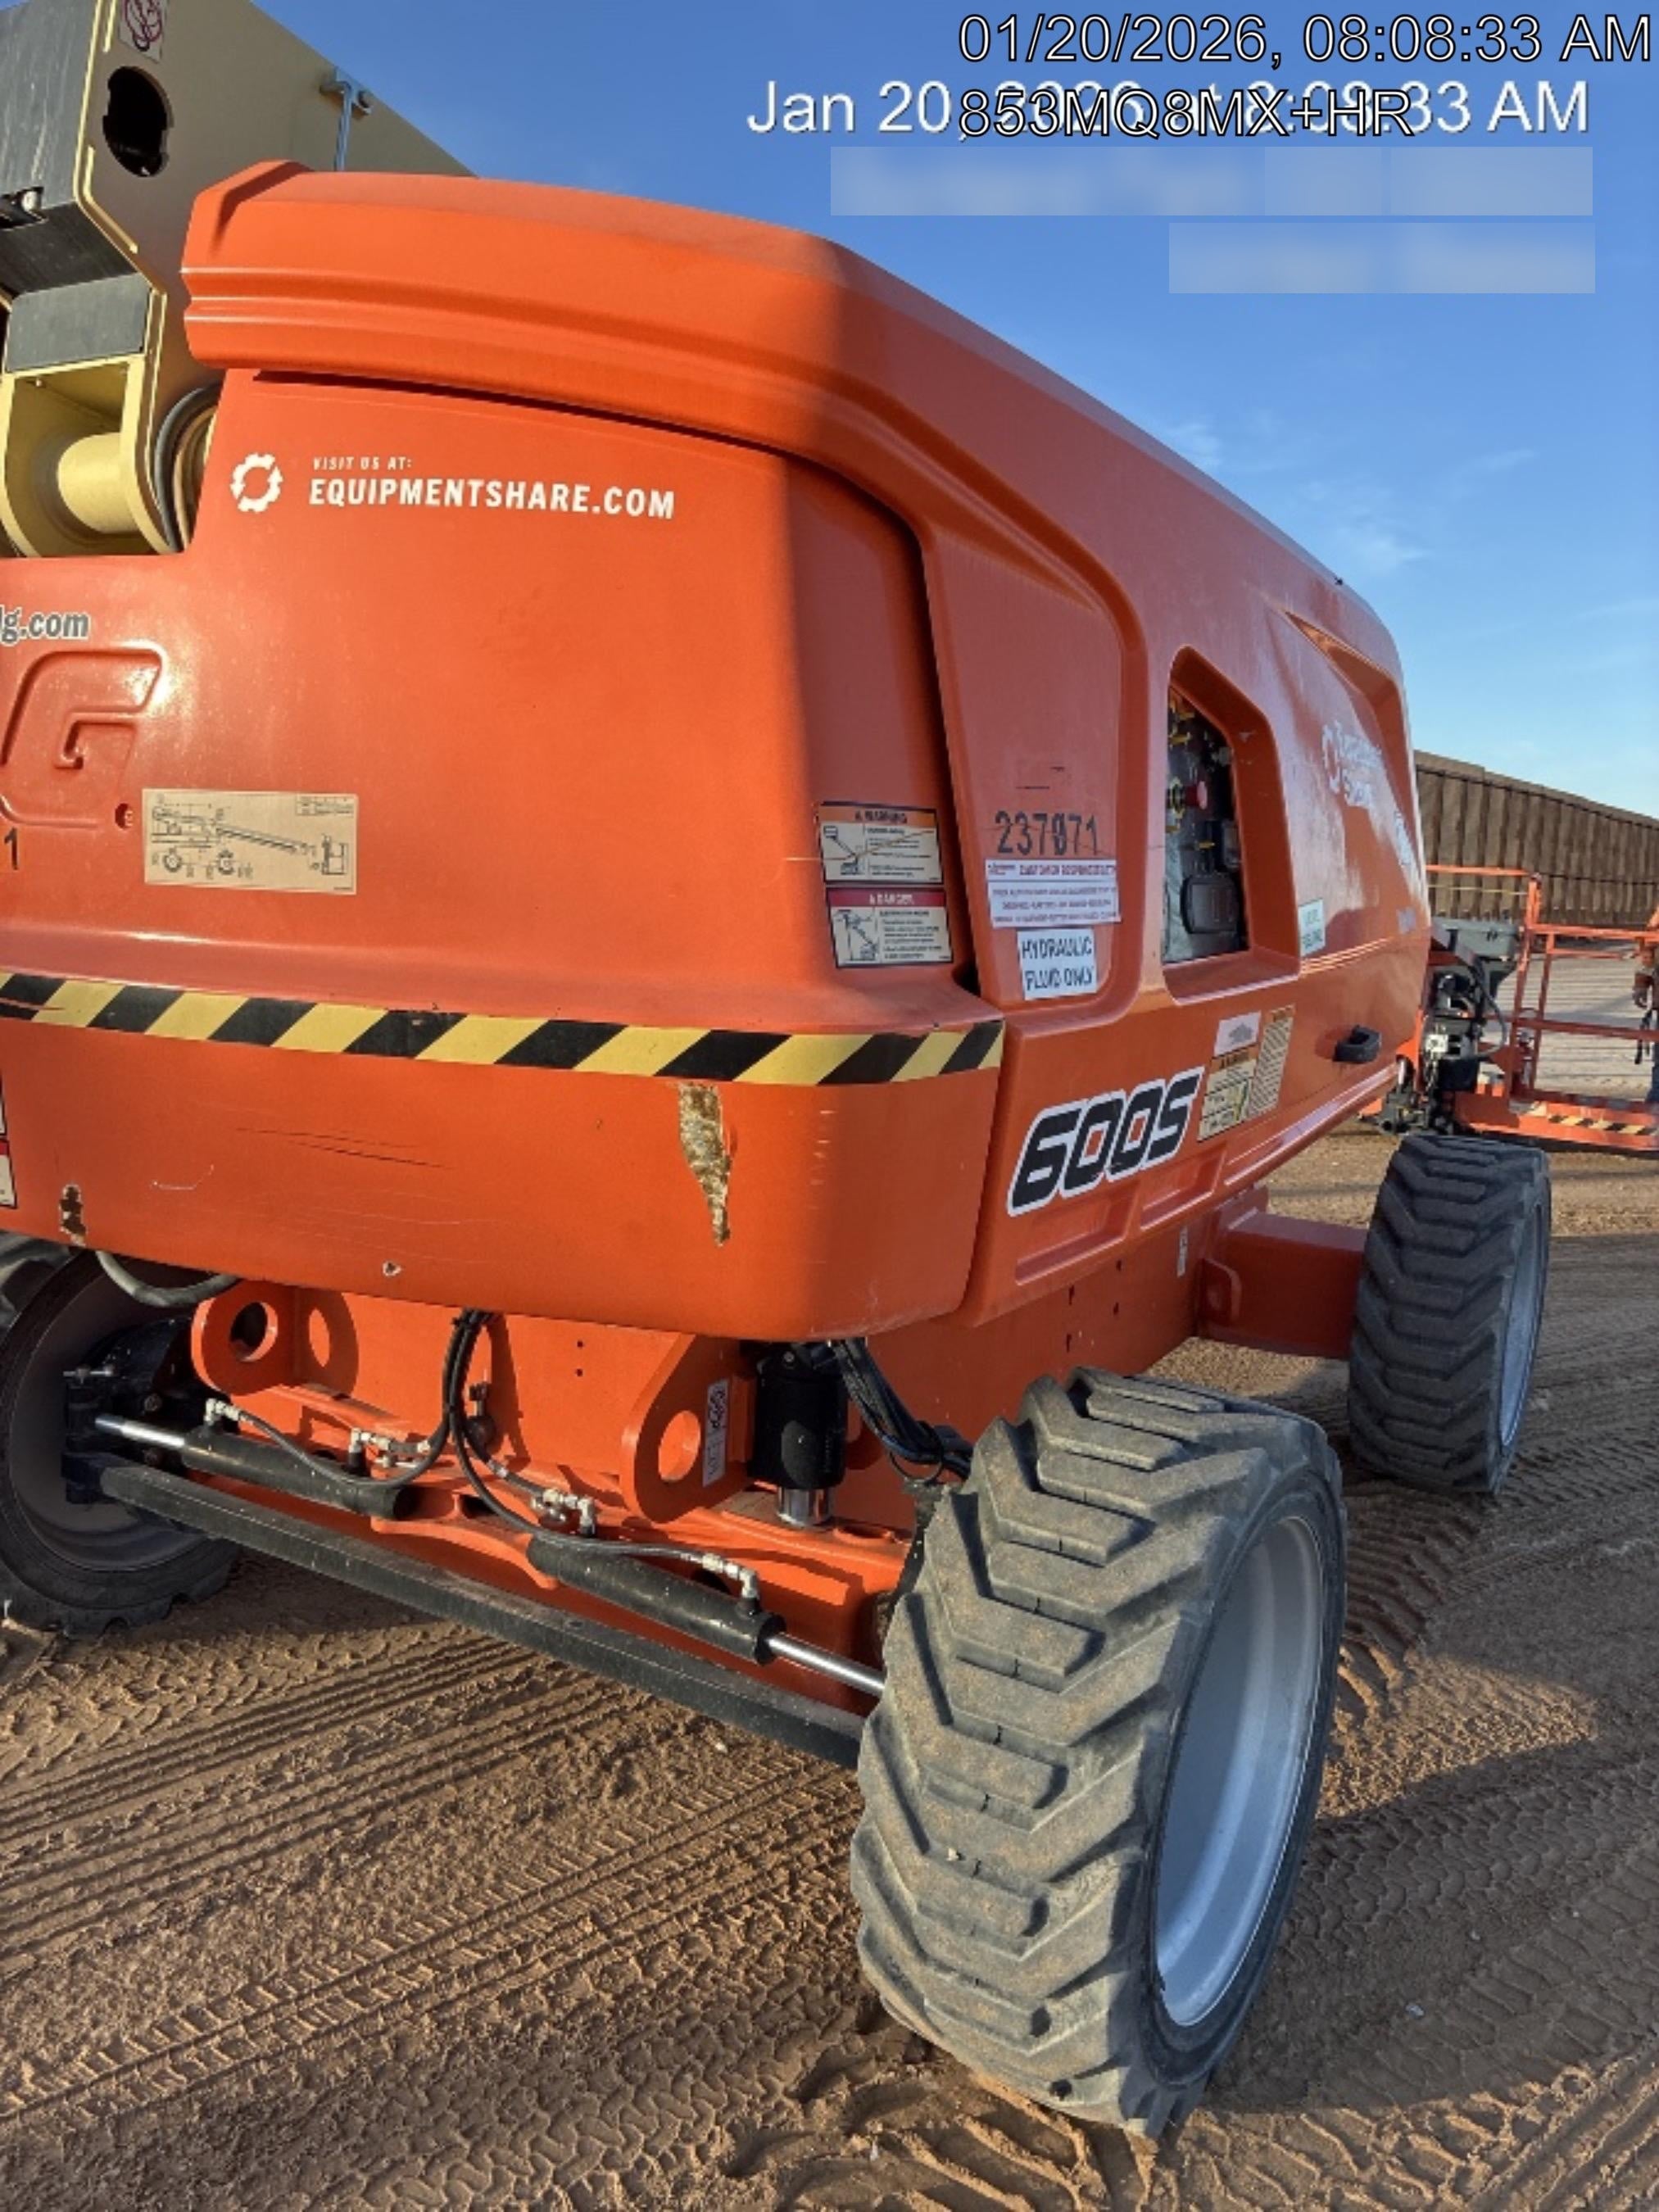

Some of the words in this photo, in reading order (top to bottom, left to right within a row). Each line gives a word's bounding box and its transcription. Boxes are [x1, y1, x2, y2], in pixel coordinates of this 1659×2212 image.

[313, 456, 354, 470] VISIT
[360, 456, 380, 470] US
[387, 456, 413, 470] AT:
[309, 478, 675, 519] EQUIPMENTSHARE.COM
[1022, 936, 1092, 959] HYDRAULIC
[1025, 968, 1061, 991] FLUID
[1064, 966, 1093, 986] ONLY
[1009, 1067, 1204, 1216] 600S
